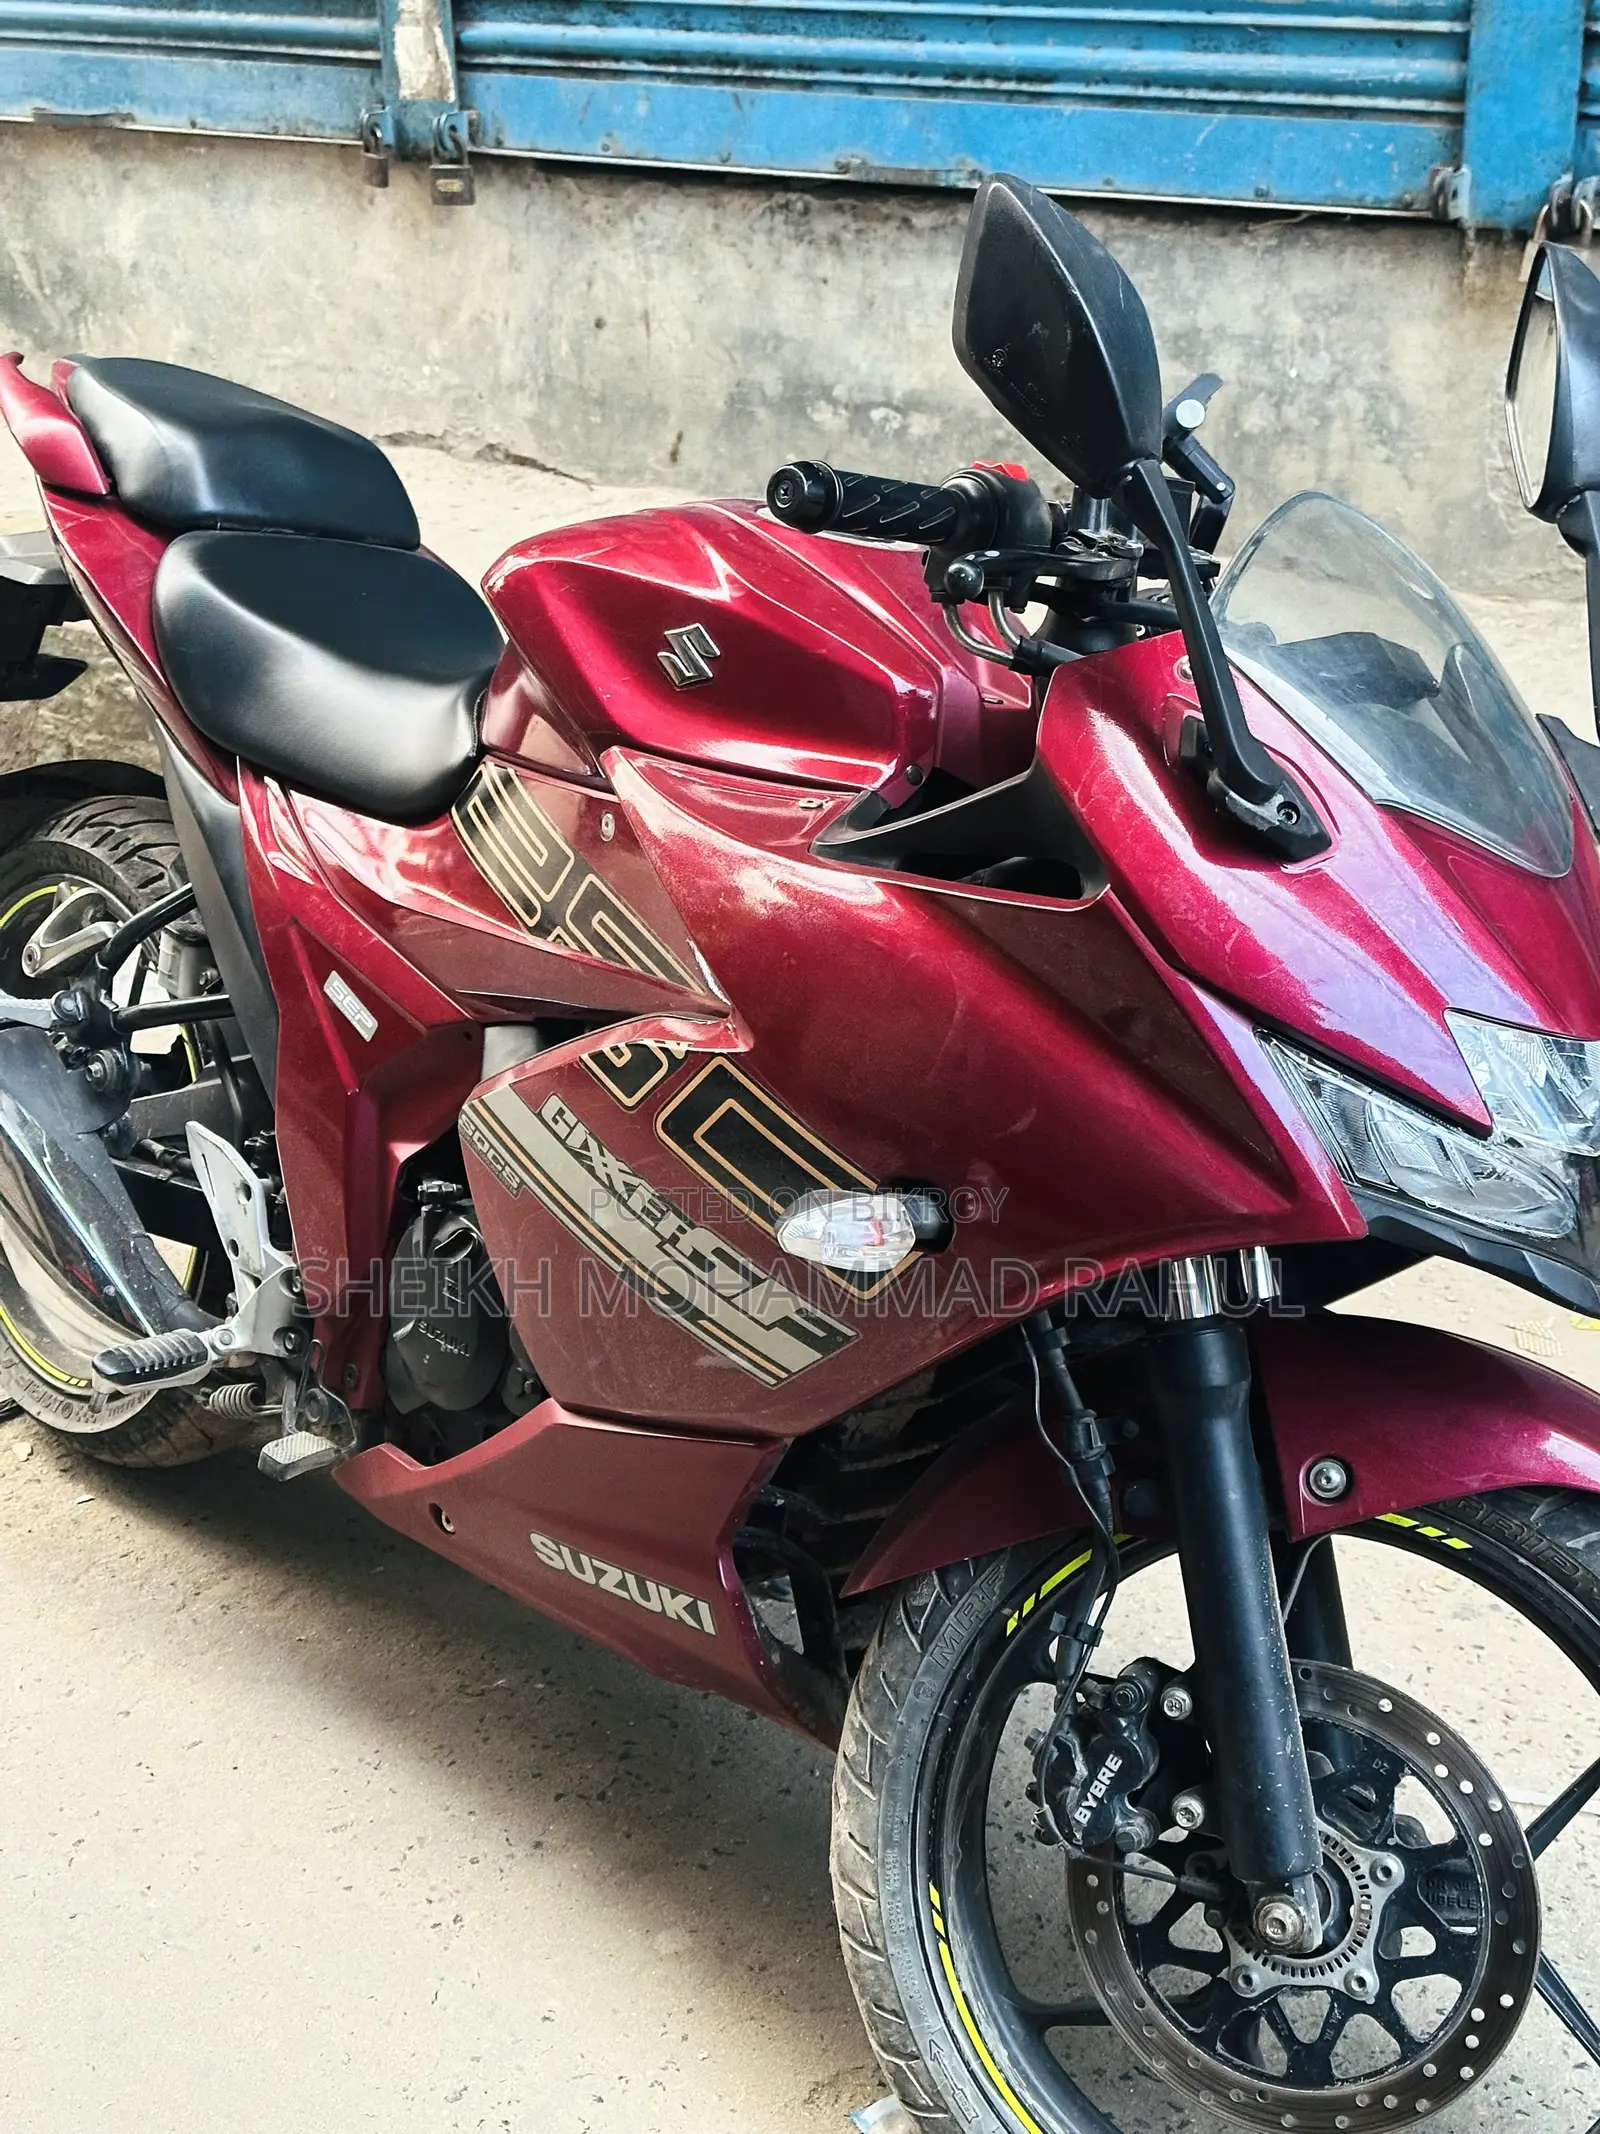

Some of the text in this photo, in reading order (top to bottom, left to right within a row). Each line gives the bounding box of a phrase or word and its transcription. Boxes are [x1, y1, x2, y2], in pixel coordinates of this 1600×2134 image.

[529, 1532, 716, 1636] SUZUKI
[930, 1564, 1006, 1670] MRF
[1073, 1753, 1123, 1826] BYBRE
